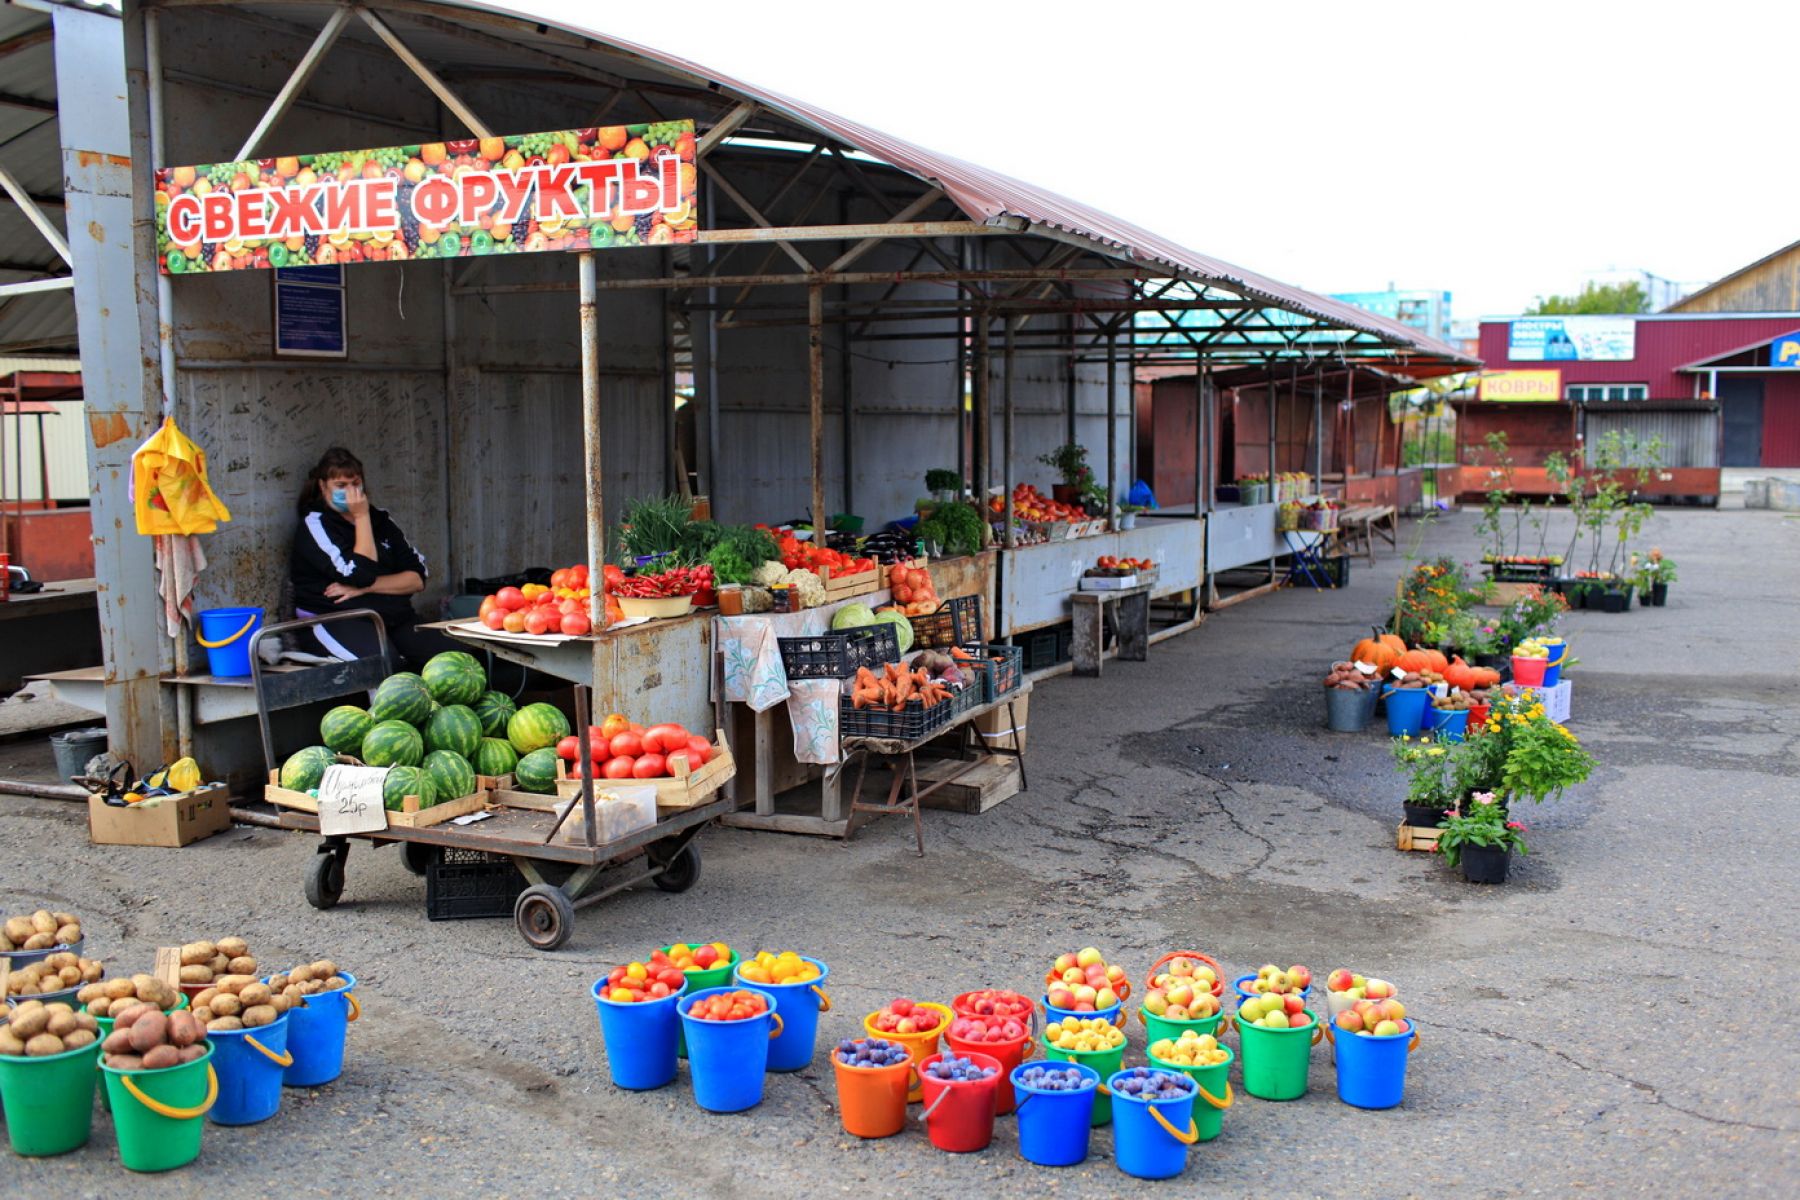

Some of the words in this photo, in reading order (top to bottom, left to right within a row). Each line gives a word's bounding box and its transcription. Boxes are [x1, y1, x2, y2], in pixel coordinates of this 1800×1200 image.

[167, 177, 399, 247] СВЕЖИЕ
[410, 154, 682, 227] ФРУКТЫ
[1487, 379, 1554, 393] КОВРЫ
